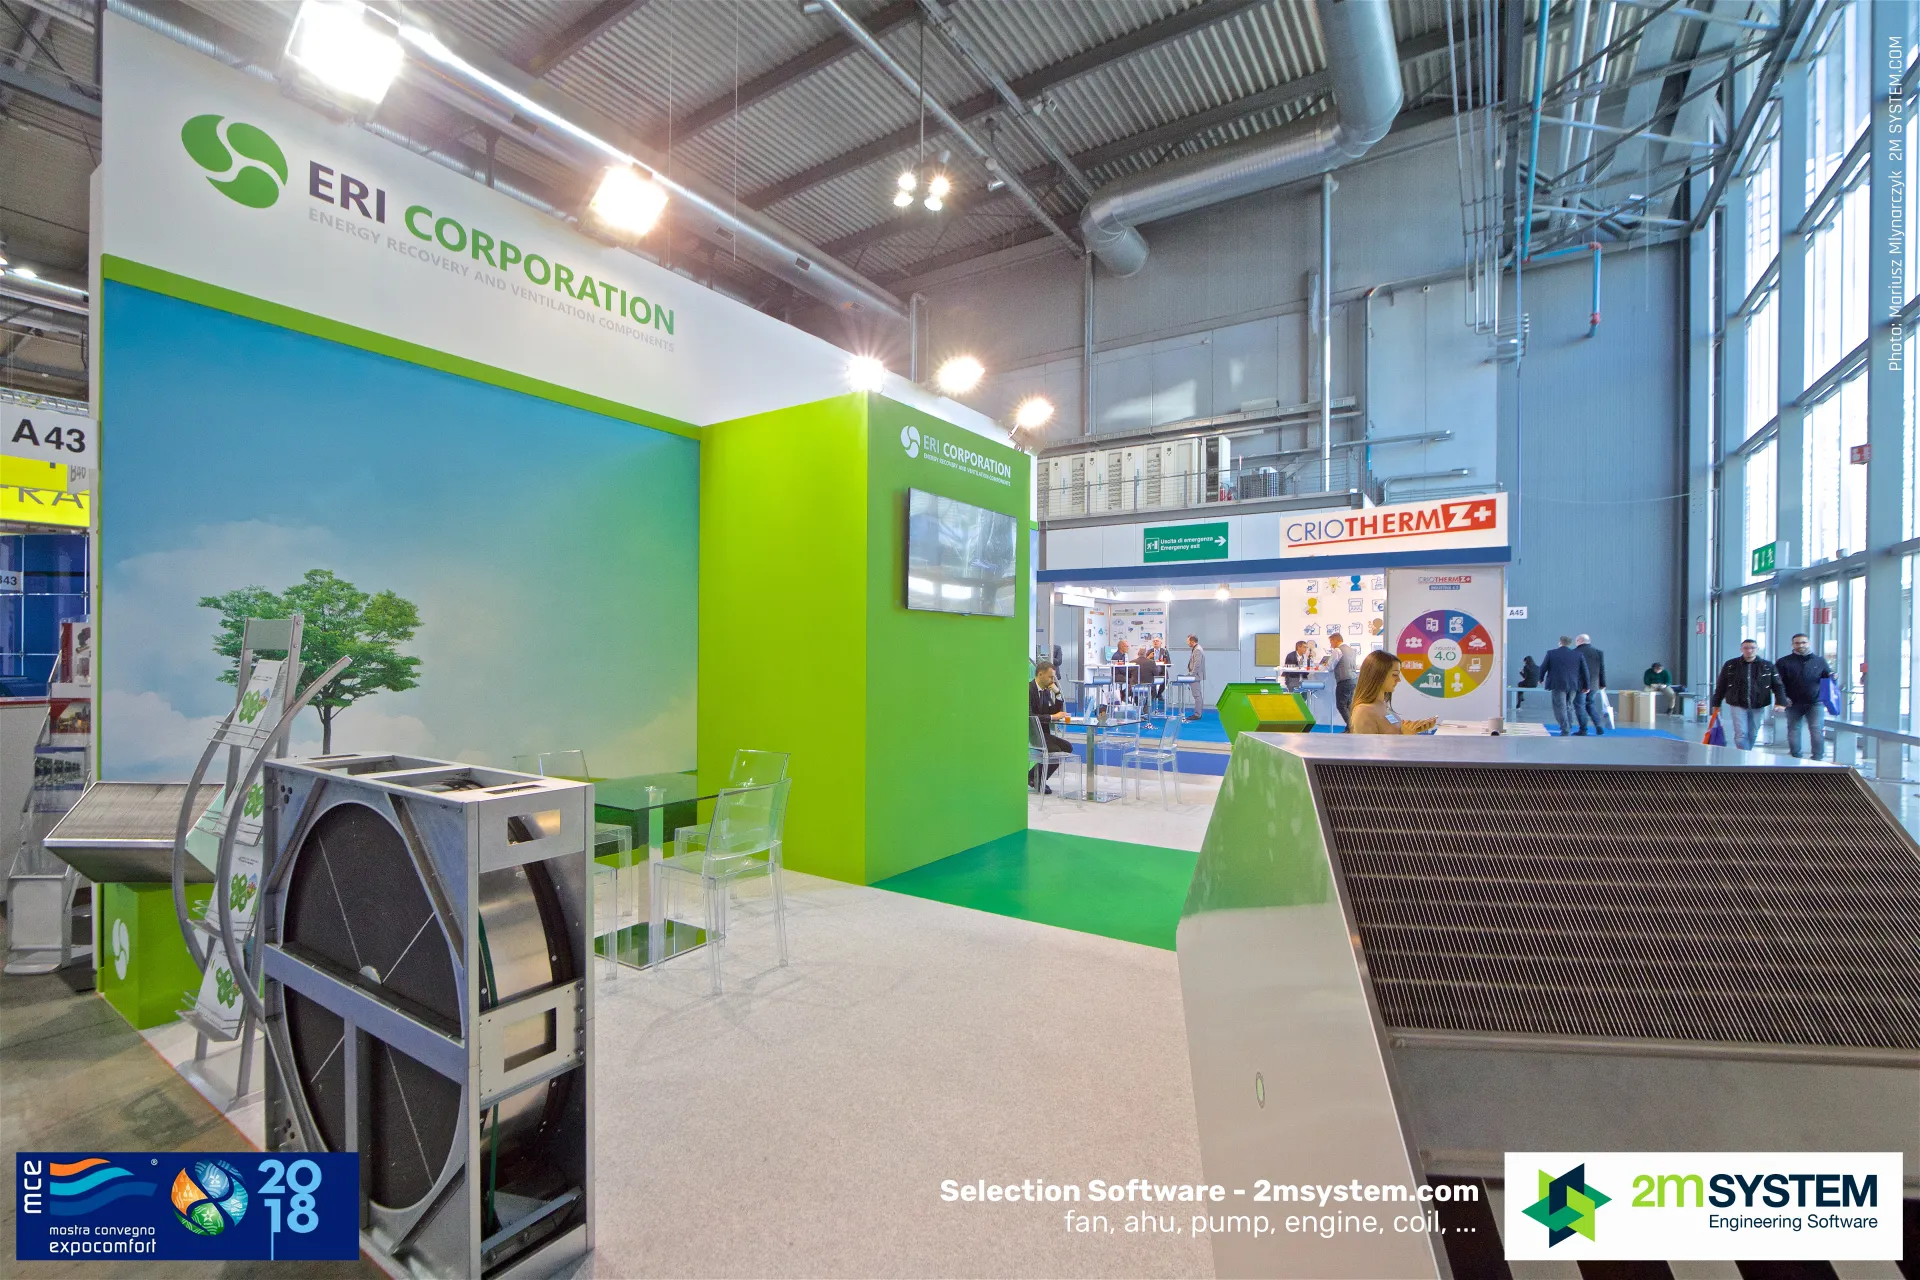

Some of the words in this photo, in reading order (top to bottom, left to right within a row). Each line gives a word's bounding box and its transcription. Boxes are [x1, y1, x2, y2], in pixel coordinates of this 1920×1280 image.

[309, 207, 381, 244] ENERGY
[387, 237, 469, 277] RECOVERY
[474, 271, 507, 291] AND
[511, 283, 595, 324] VENTILATION
[598, 317, 674, 352] COMPONENTS
[310, 160, 386, 224] ERI
[404, 205, 675, 335] CORPORATION
[923, 434, 940, 454] ERI
[943, 442, 1011, 478] CORPORATION
[1434, 651, 1456, 660] 4.0
